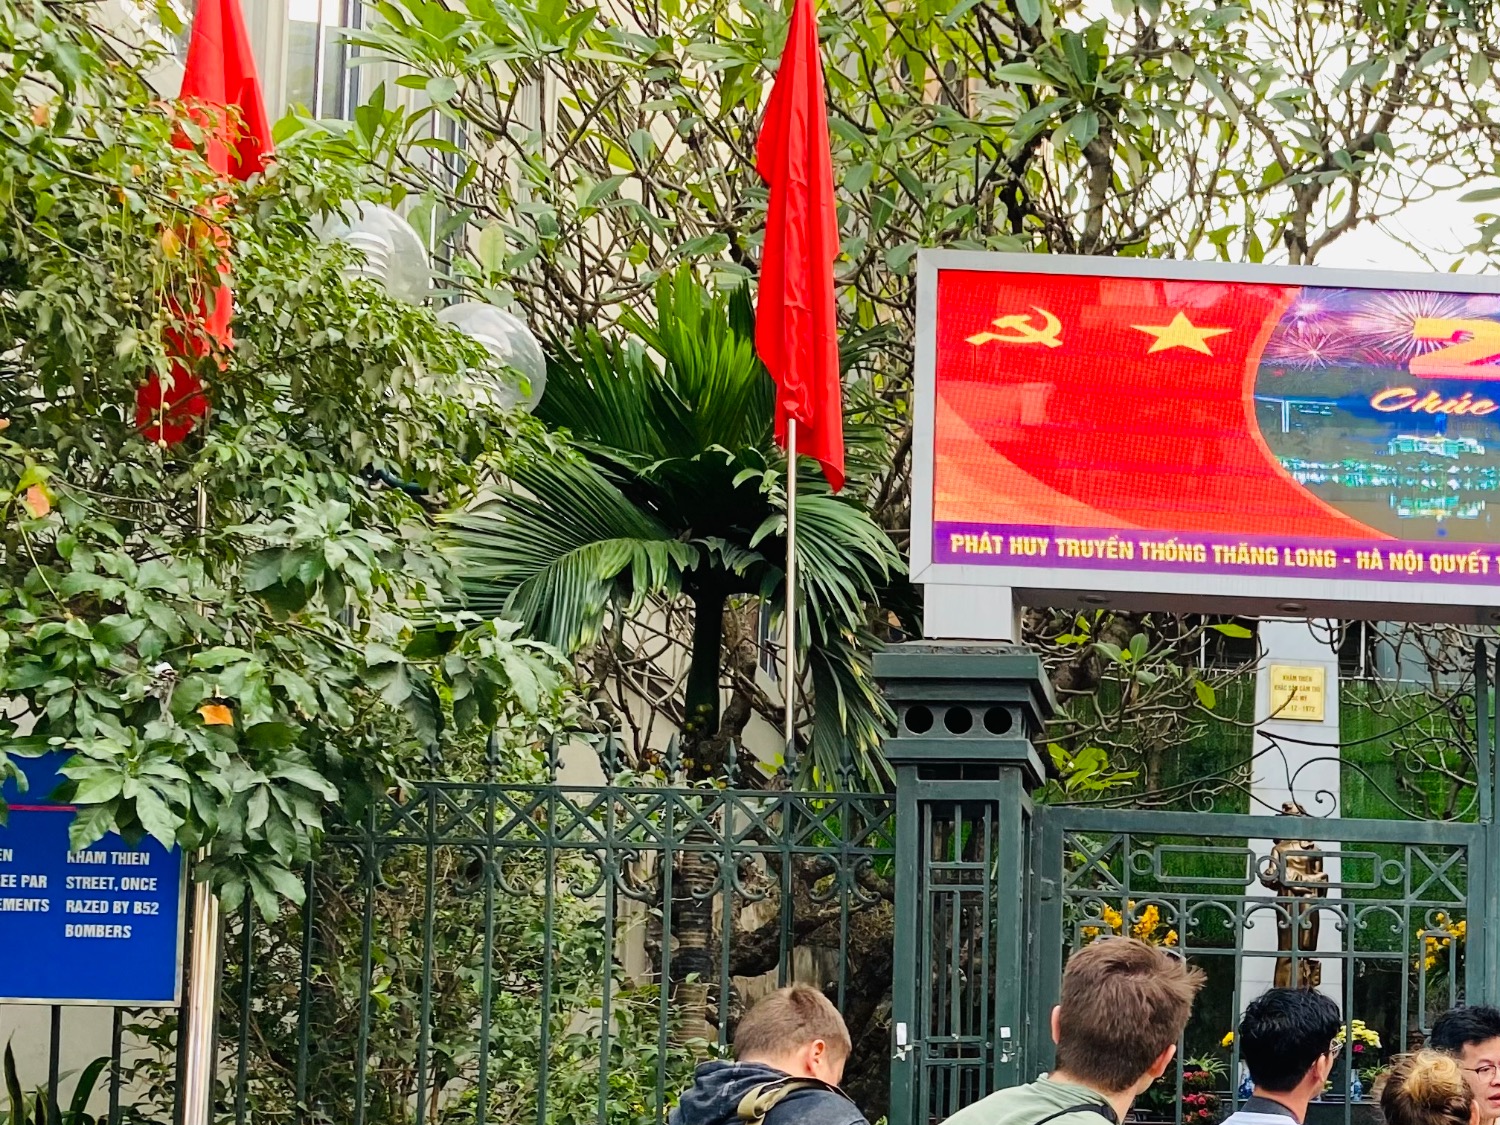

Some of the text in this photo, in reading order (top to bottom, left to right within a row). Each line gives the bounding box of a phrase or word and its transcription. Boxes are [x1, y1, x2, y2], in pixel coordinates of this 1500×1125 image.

[1370, 387, 1499, 416] Chúc
[950, 531, 1003, 555] PHÁT
[1009, 536, 1049, 557] HUY
[1055, 535, 1134, 560] TRUYỀN
[1138, 536, 1206, 563] THỐNG
[1211, 542, 1279, 567] THĂNG
[1284, 547, 1337, 568] LONG
[1356, 548, 1383, 571] HÀ
[1389, 549, 1423, 576] NỘI
[1429, 549, 1491, 575] QUYẾT
[110, 851, 150, 866] THIEN
[21, 875, 48, 889] PAR
[121, 877, 157, 891] ONCE
[66, 900, 159, 915] RAZED BY B52
[65, 924, 132, 939] BOMBERS
